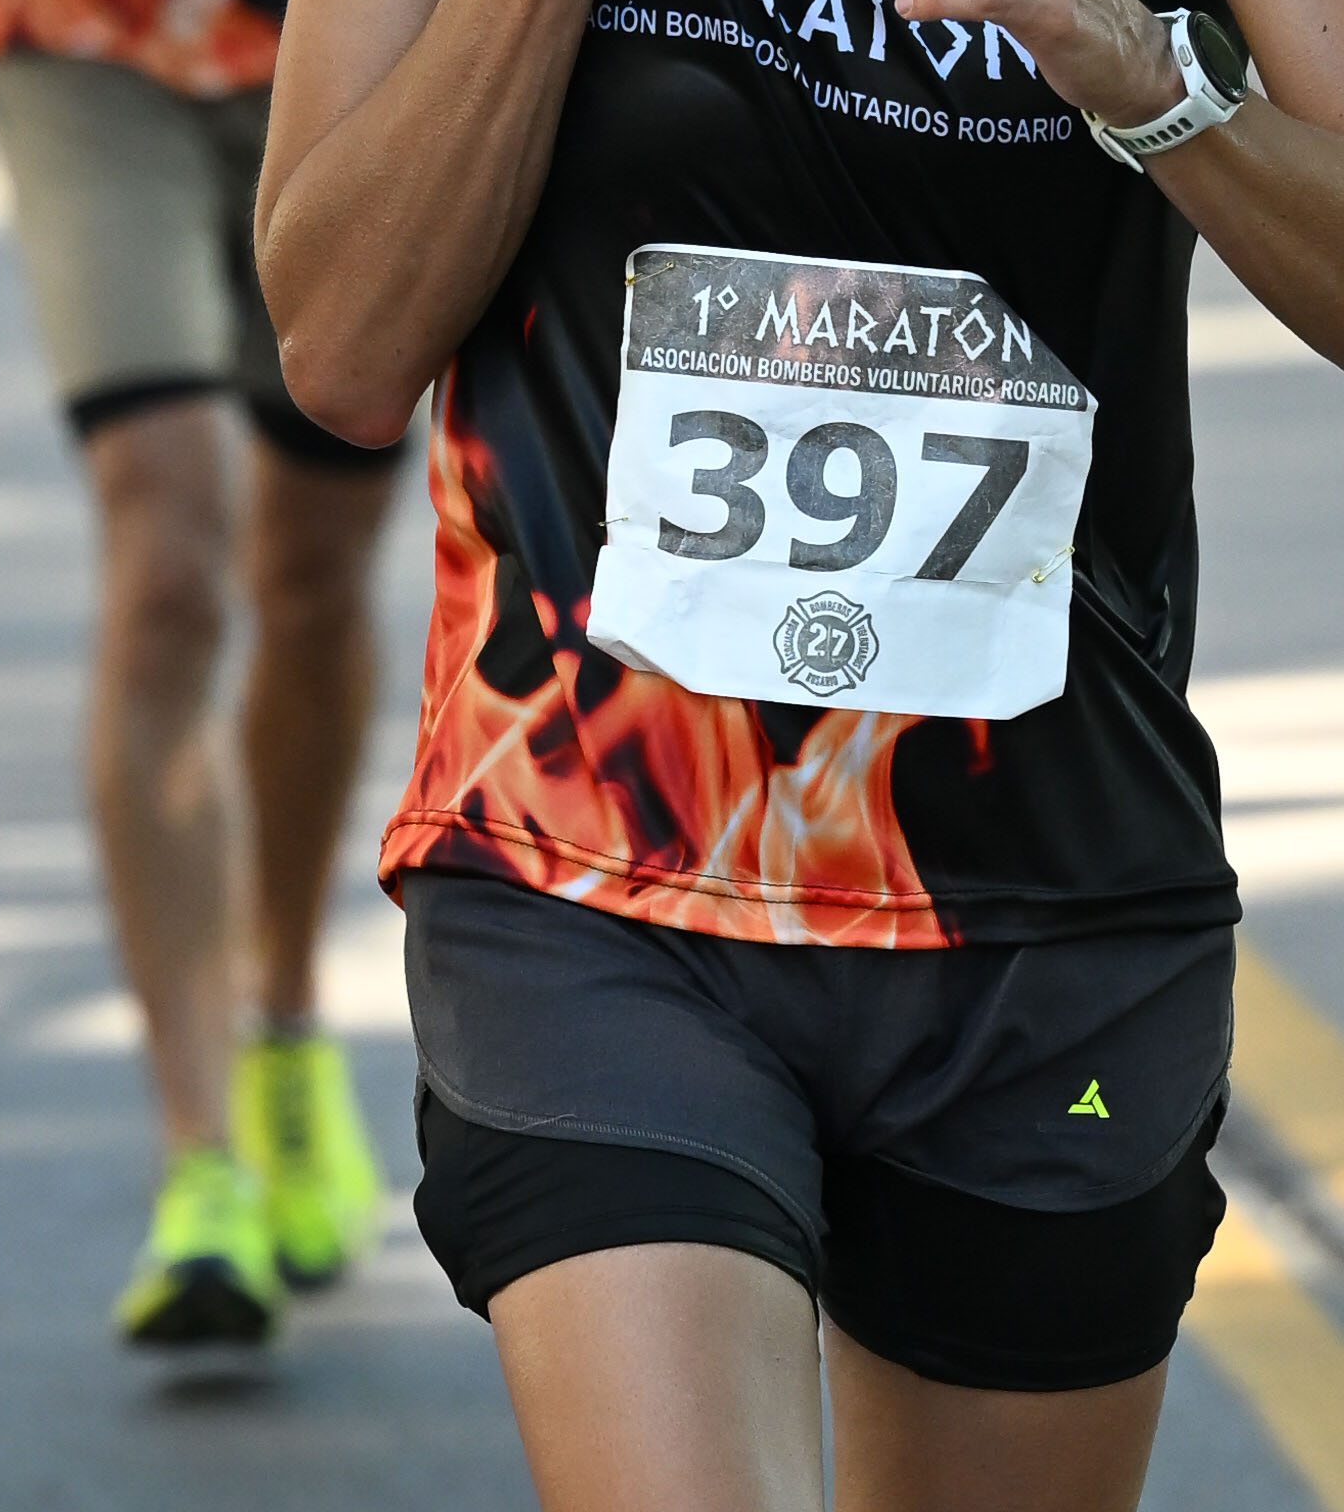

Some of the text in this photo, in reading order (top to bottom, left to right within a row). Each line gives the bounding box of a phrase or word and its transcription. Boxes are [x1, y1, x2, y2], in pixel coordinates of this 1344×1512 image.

[958, 115, 1072, 143] ROSARIO
[754, 290, 1033, 365] MARATÓN
[640, 345, 1080, 407] ASOCIACIÓN BOMBEROS VOLUNTARIOS ROSARIO
[656, 409, 1030, 582] 397
[809, 600, 853, 618] BOMBEROS
